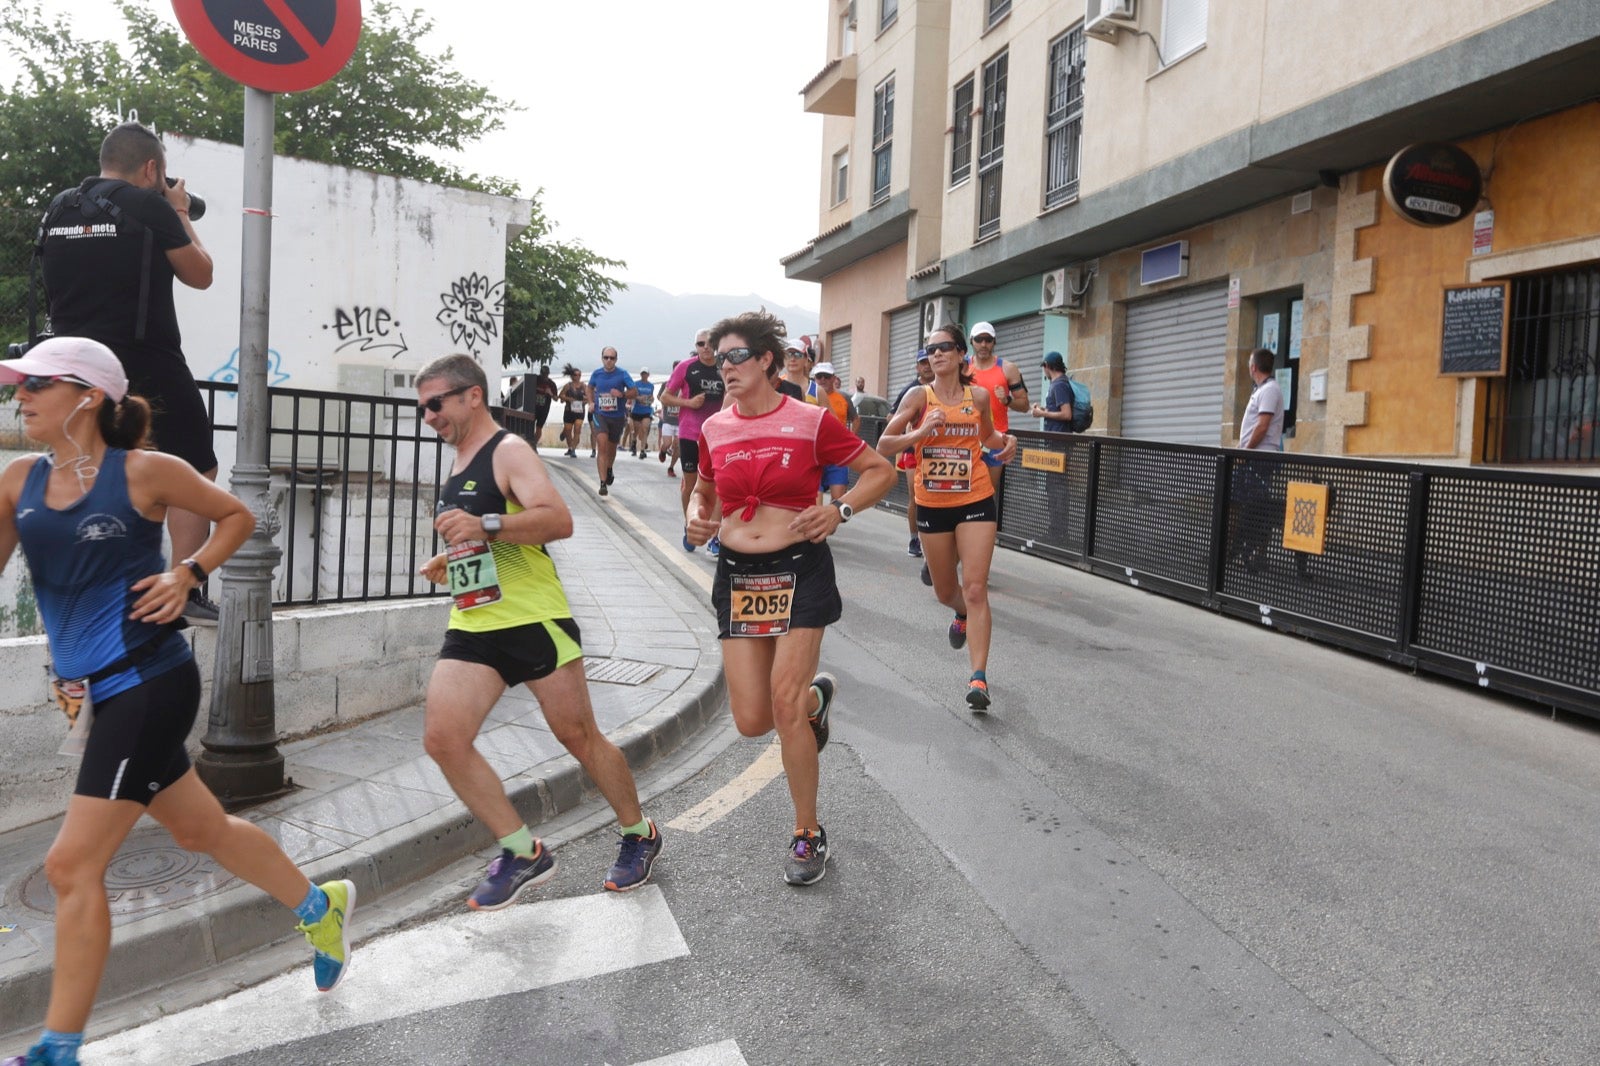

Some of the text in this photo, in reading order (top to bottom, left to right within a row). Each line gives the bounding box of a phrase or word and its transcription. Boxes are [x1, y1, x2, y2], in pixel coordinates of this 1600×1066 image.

[234, 19, 281, 40] MESES
[233, 34, 278, 53] PARES
[928, 462, 968, 476] 2279
[741, 594, 789, 616] 2059
